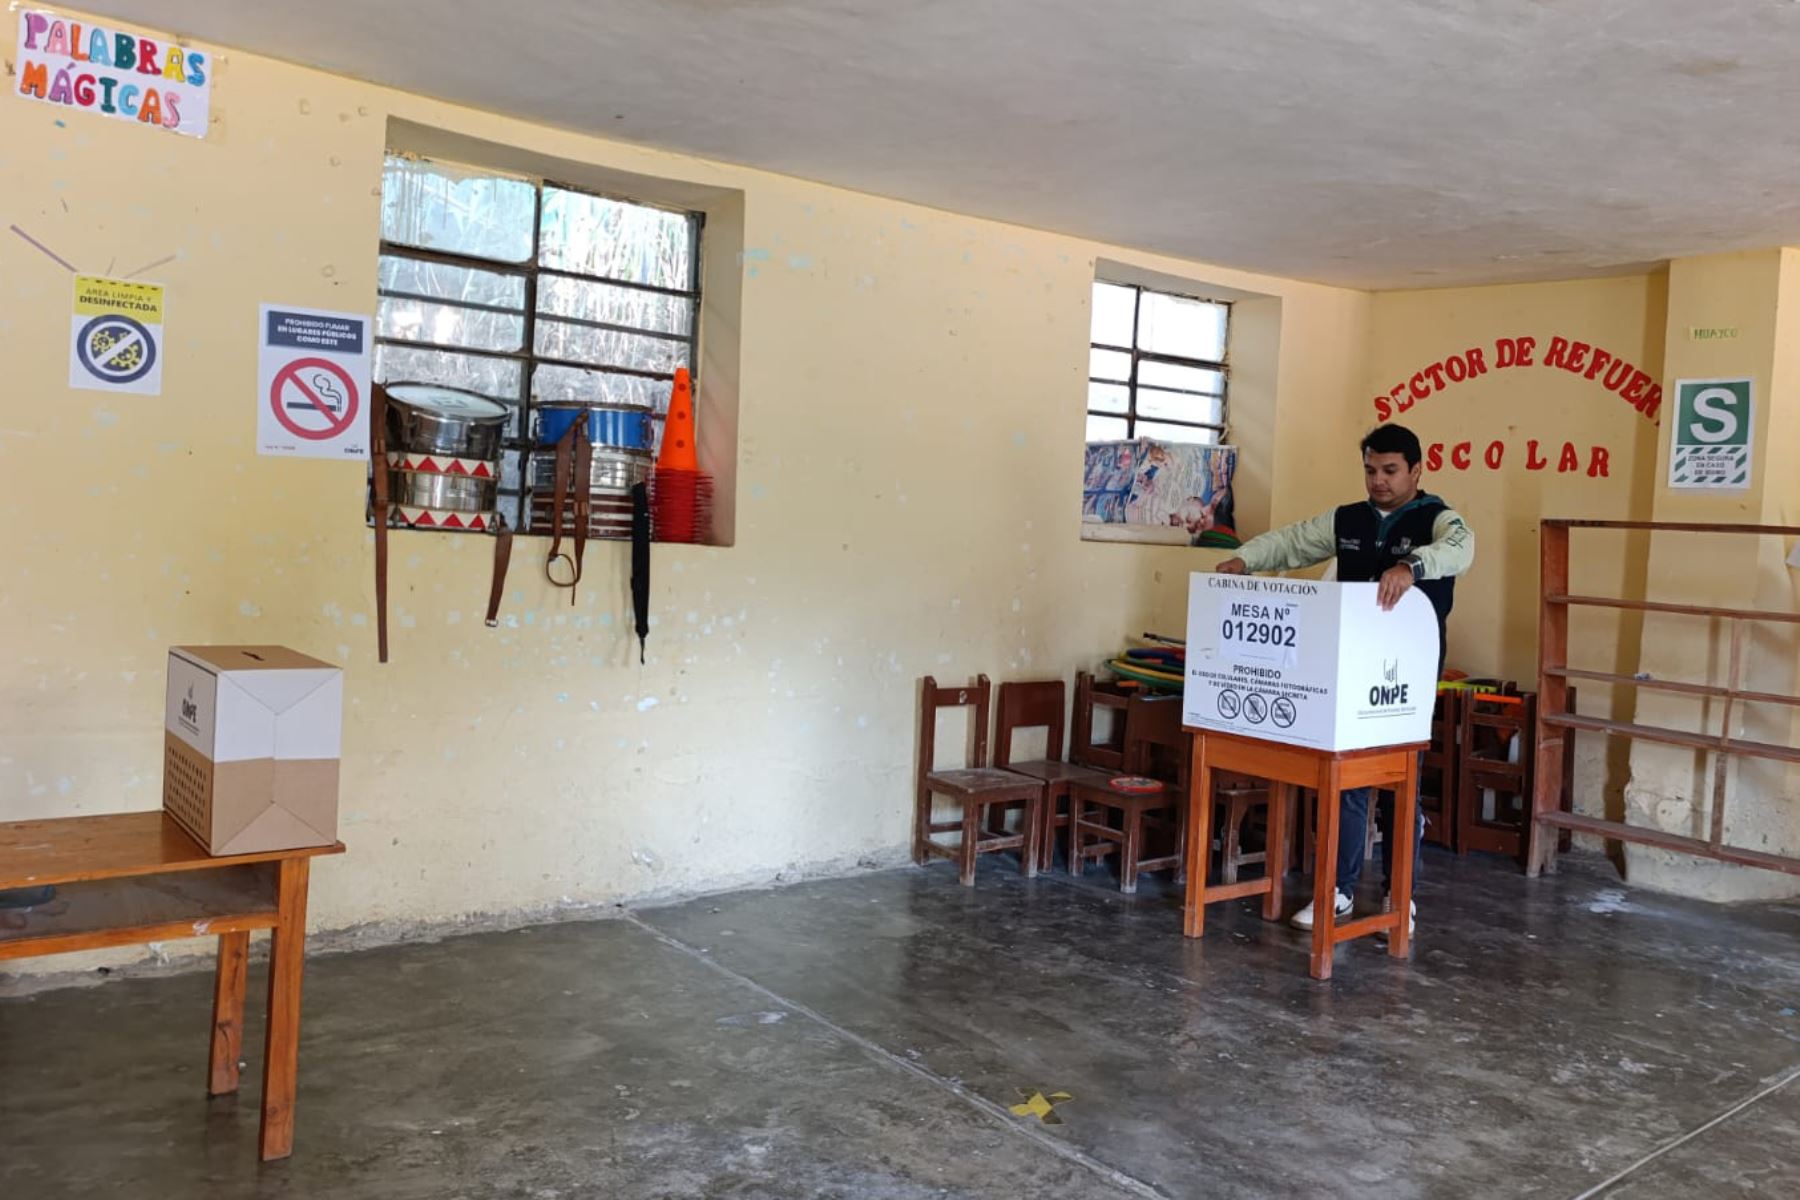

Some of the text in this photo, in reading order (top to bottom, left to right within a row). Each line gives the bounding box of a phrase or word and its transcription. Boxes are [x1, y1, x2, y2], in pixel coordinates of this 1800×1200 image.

[24, 13, 206, 87] PALABRAS
[20, 60, 181, 129] MÁGICAS
[79, 295, 158, 312] DESINFECTADA
[277, 325, 357, 340] EN LUGARES PÚBLICOS
[285, 318, 350, 332] PROHIBIDO FUMAR
[1694, 328, 1737, 340] HUAYCO
[296, 335, 338, 346] COMO ESTE
[1374, 336, 1662, 426] SECTOR DE REFUER
[1689, 387, 1738, 443] S
[1425, 439, 1610, 478] SCOLAR
[1208, 577, 1319, 595] CABINA DE VOTACIÓN
[1231, 602, 1270, 620] MESA
[1222, 619, 1296, 648] 012902
[1233, 664, 1281, 680] PROHIBIDO
[1280, 681, 1328, 695] FOTOGRÁFICAS
[1281, 690, 1308, 701] SECRETA
[1369, 684, 1409, 706] ONPE
